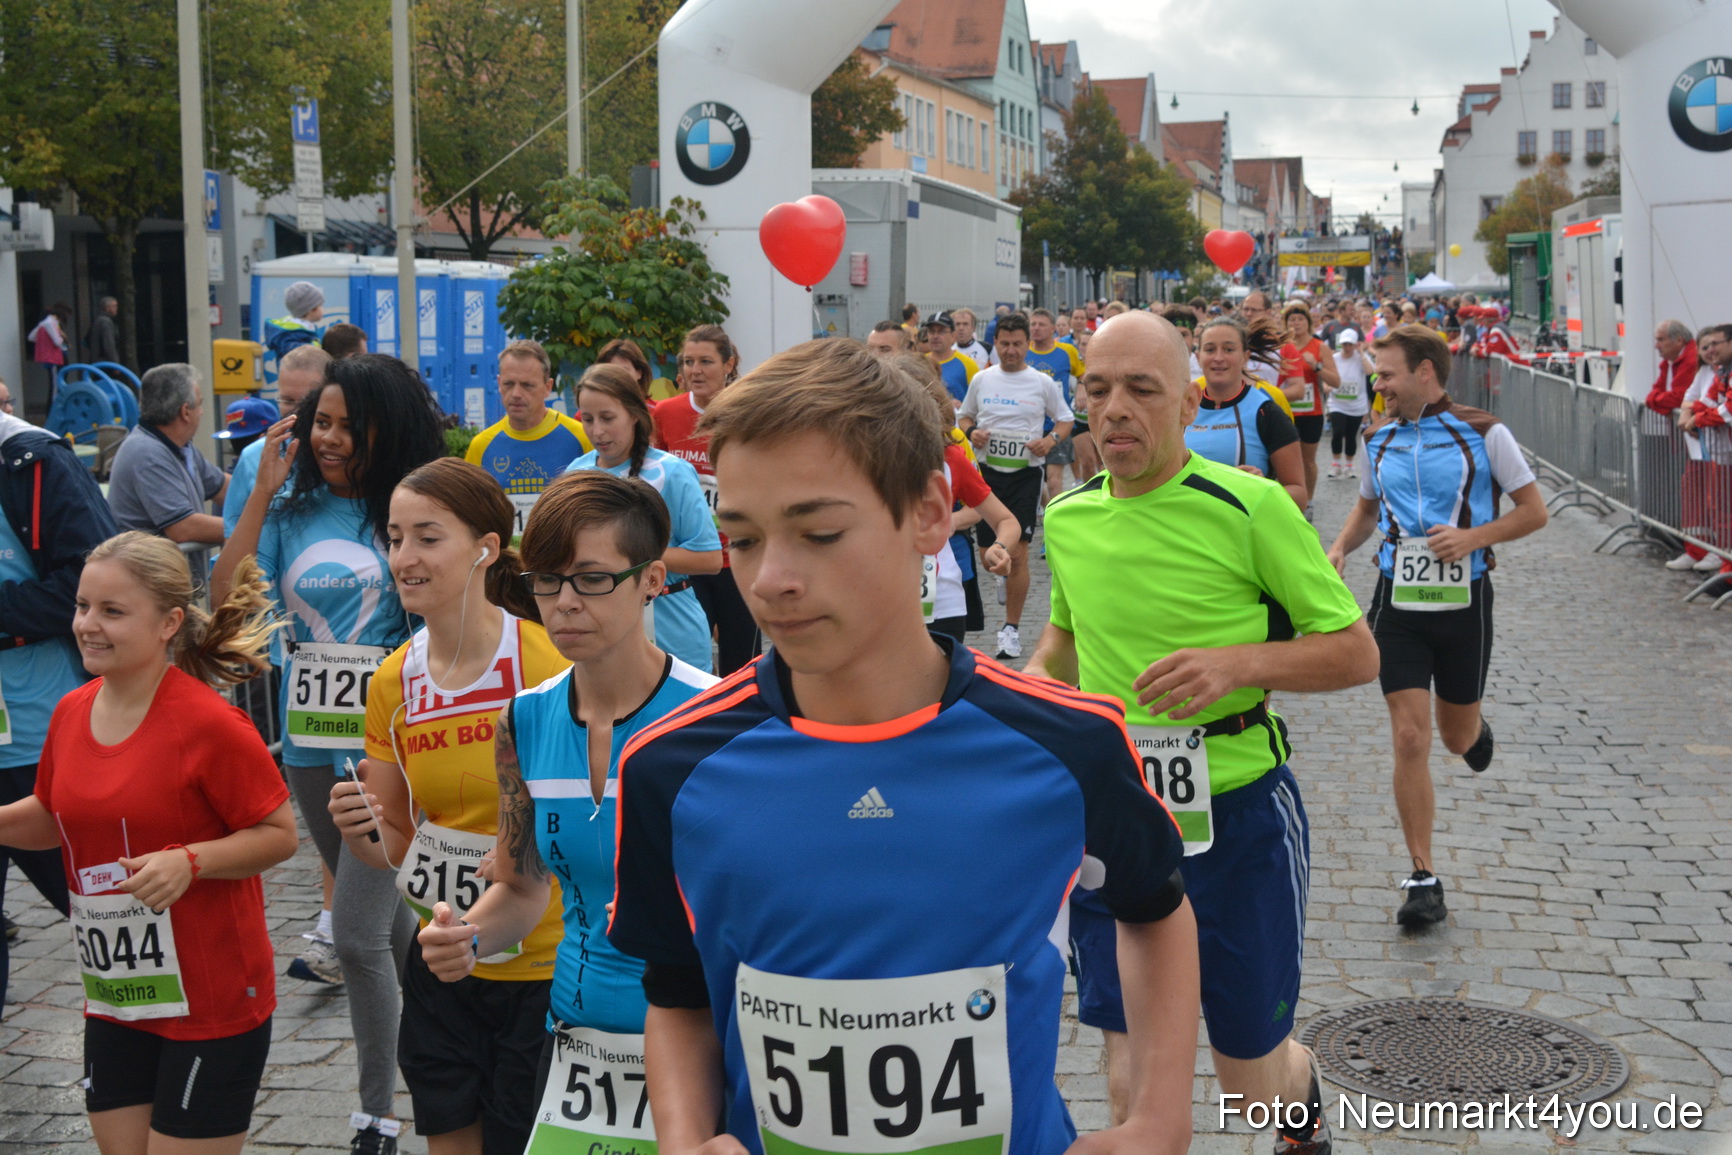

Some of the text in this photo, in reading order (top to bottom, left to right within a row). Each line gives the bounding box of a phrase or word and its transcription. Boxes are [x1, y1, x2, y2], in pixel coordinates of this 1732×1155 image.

[680, 103, 744, 132] BMW
[242, 254, 250, 273] 3
[1308, 255, 1339, 264] START
[669, 450, 711, 463] EUMA
[989, 439, 1026, 457] 5507
[1402, 555, 1463, 582] 5215
[300, 574, 356, 589] anders
[360, 575, 382, 590] als
[1418, 589, 1444, 600] Sven
[320, 654, 372, 666] Neumarkt
[305, 717, 359, 734] Pamela
[407, 729, 450, 755] MAX
[457, 717, 497, 746] BÖ
[848, 806, 894, 819] adidas
[439, 839, 491, 858] Neumar
[407, 852, 494, 912] 515
[87, 906, 146, 921] Neumarkt
[75, 922, 165, 972] 5044
[95, 982, 157, 1003] Christina
[740, 990, 955, 1030] PARTL Neumarkt
[561, 1062, 649, 1130] 517
[763, 1034, 985, 1139] 5194
